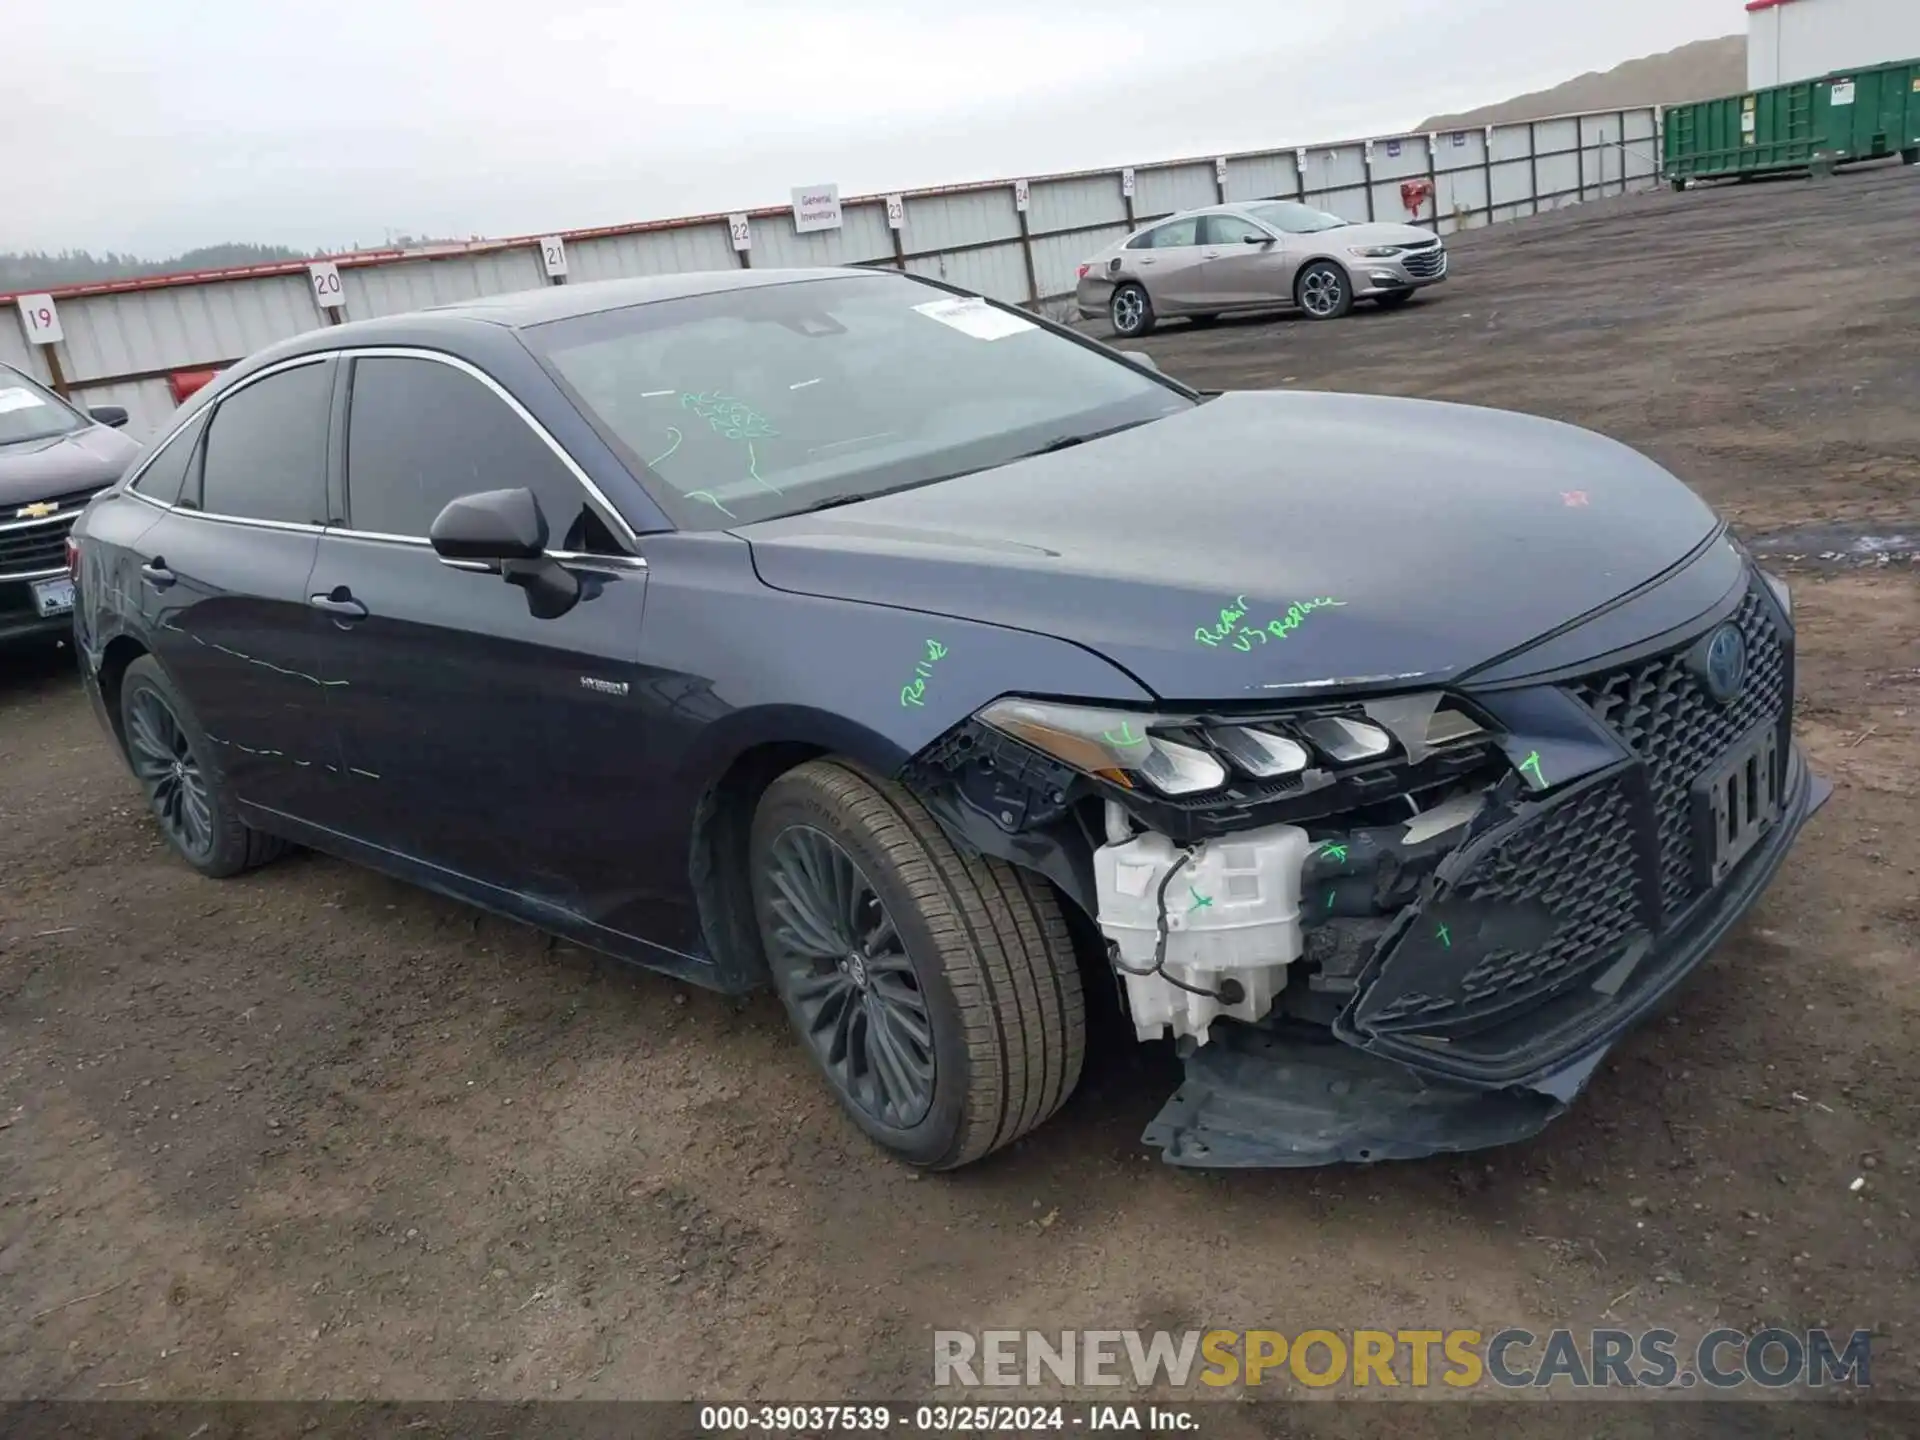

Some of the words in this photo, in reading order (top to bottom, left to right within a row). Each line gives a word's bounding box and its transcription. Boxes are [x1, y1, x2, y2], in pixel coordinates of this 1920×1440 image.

[1124, 175, 1133, 188] 25
[802, 193, 831, 206] General
[1017, 189, 1027, 202] 24
[889, 204, 902, 220] 23
[732, 223, 749, 240] 22
[547, 247, 563, 265] 21
[314, 273, 340, 295] 20
[28, 308, 51, 330] 19
